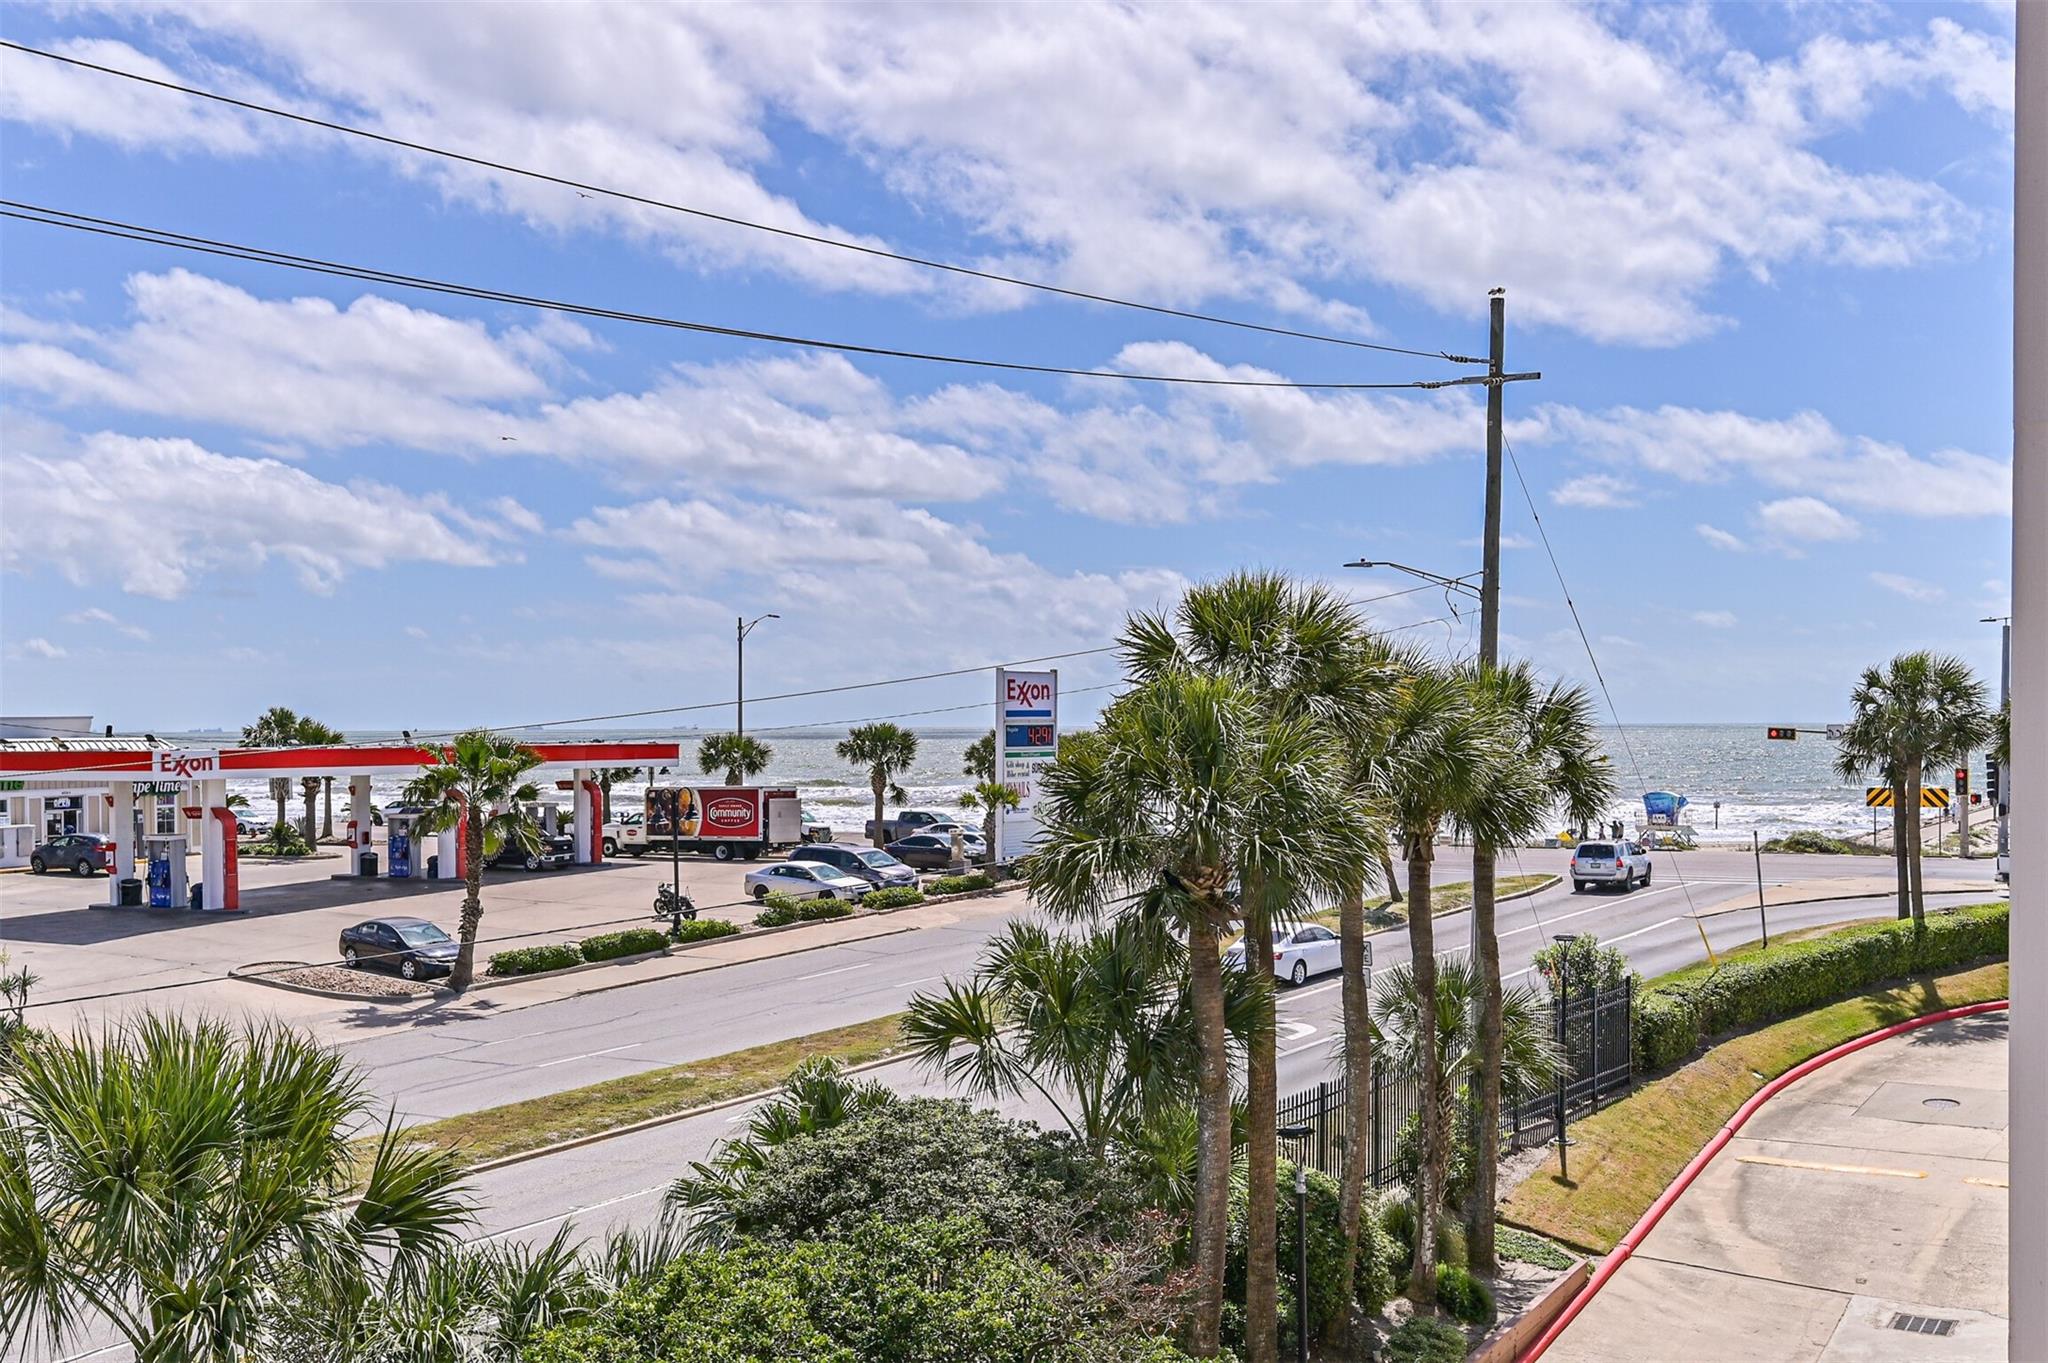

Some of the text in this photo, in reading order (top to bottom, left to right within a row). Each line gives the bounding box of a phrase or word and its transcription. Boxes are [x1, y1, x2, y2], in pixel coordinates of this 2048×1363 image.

[1007, 679, 1050, 708] Exxon
[160, 753, 213, 778] Exxon
[152, 780, 181, 793] Time
[709, 806, 751, 820] Community
